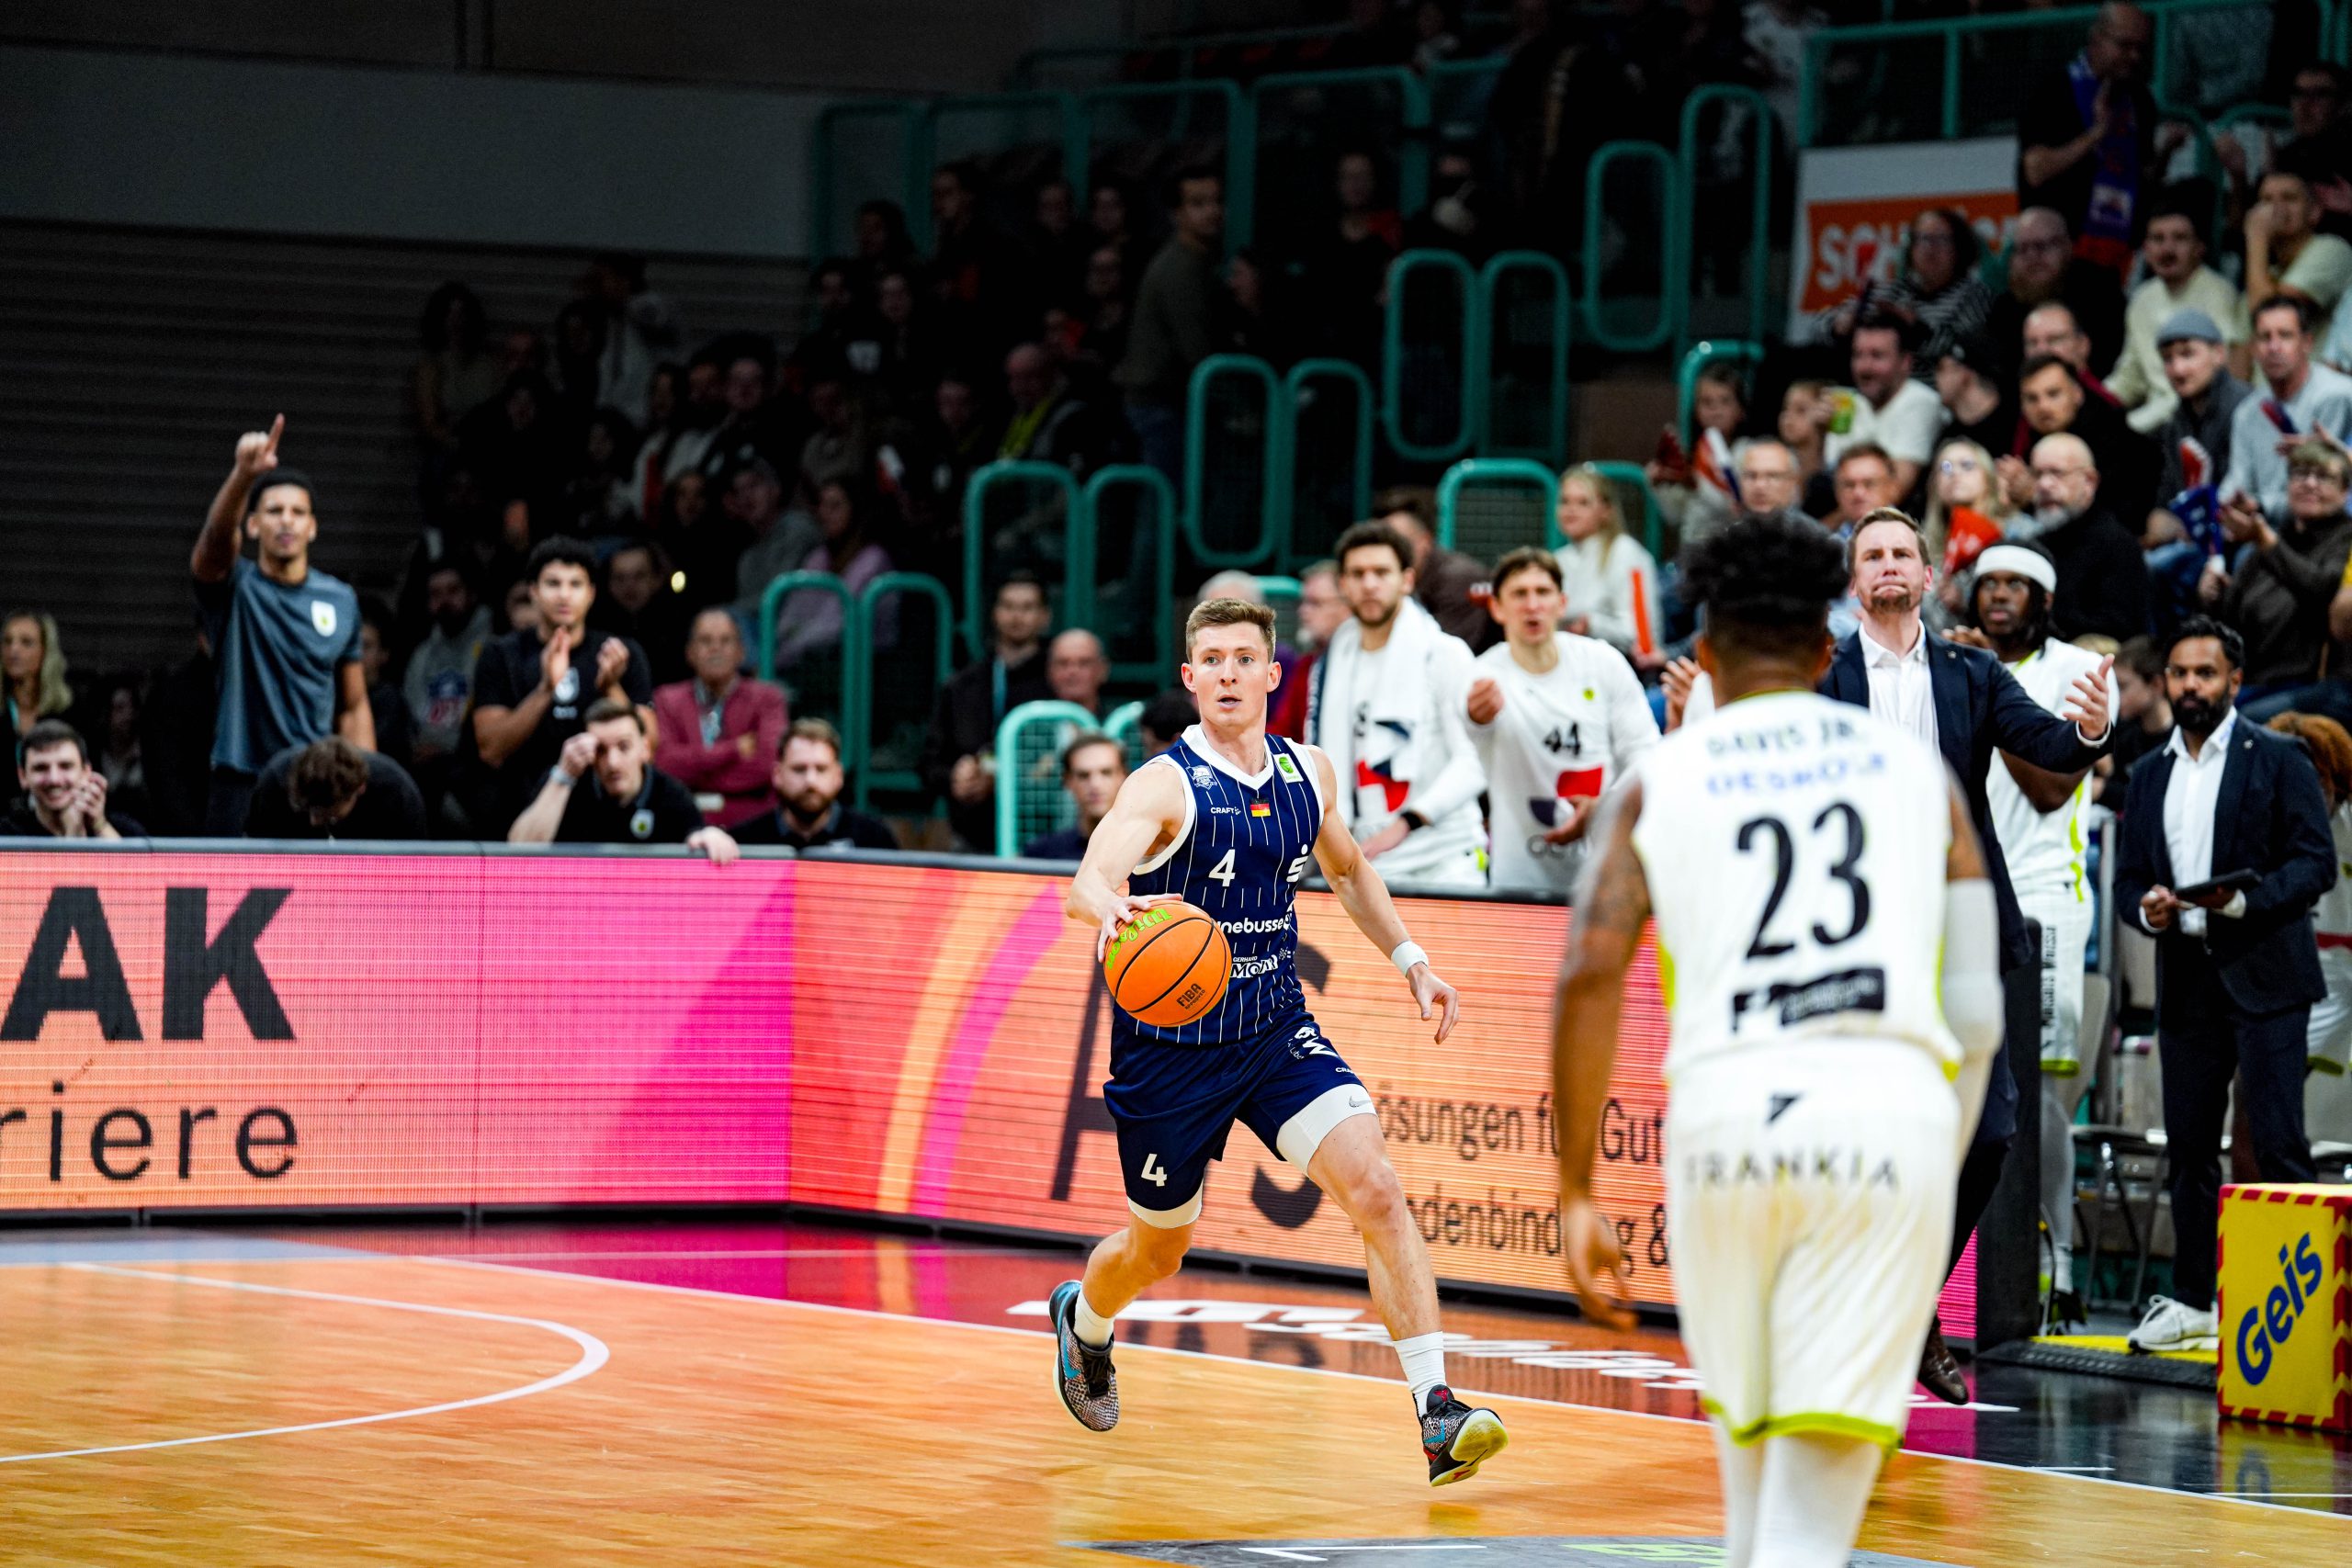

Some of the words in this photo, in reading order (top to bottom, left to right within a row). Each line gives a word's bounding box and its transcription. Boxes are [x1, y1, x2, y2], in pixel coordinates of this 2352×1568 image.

[1544, 721, 1581, 757] 44
[1210, 807, 1234, 815] CRAFT
[1208, 849, 1236, 887] 4
[1736, 800, 1871, 961] 23
[1106, 908, 1173, 970] Wilson
[0, 886, 297, 1042] AK
[1176, 983, 1203, 1008] FIBA
[1183, 988, 1206, 1010] APPROVED
[1379, 1081, 1524, 1161] ösungen
[1141, 1153, 1168, 1187] 4
[2235, 1232, 2324, 1385] Geis
